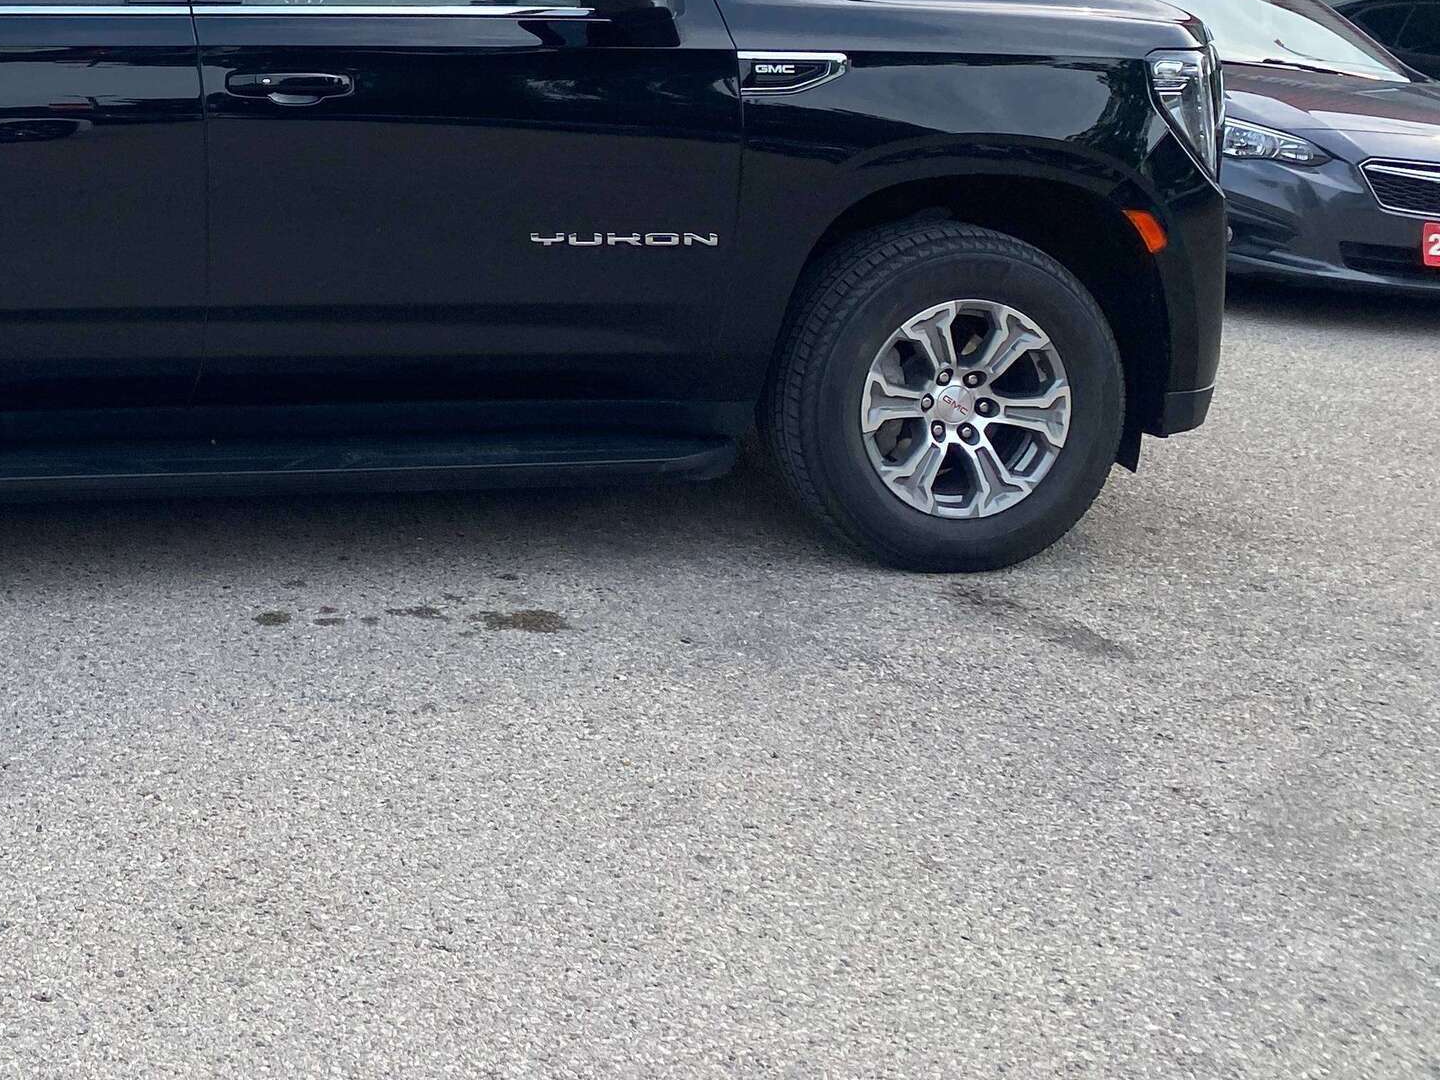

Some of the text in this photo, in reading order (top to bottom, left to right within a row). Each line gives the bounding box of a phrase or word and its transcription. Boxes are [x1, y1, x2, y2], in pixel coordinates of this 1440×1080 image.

[754, 64, 796, 74] GMC
[530, 232, 719, 247] YUKON
[942, 394, 969, 416] GMC
